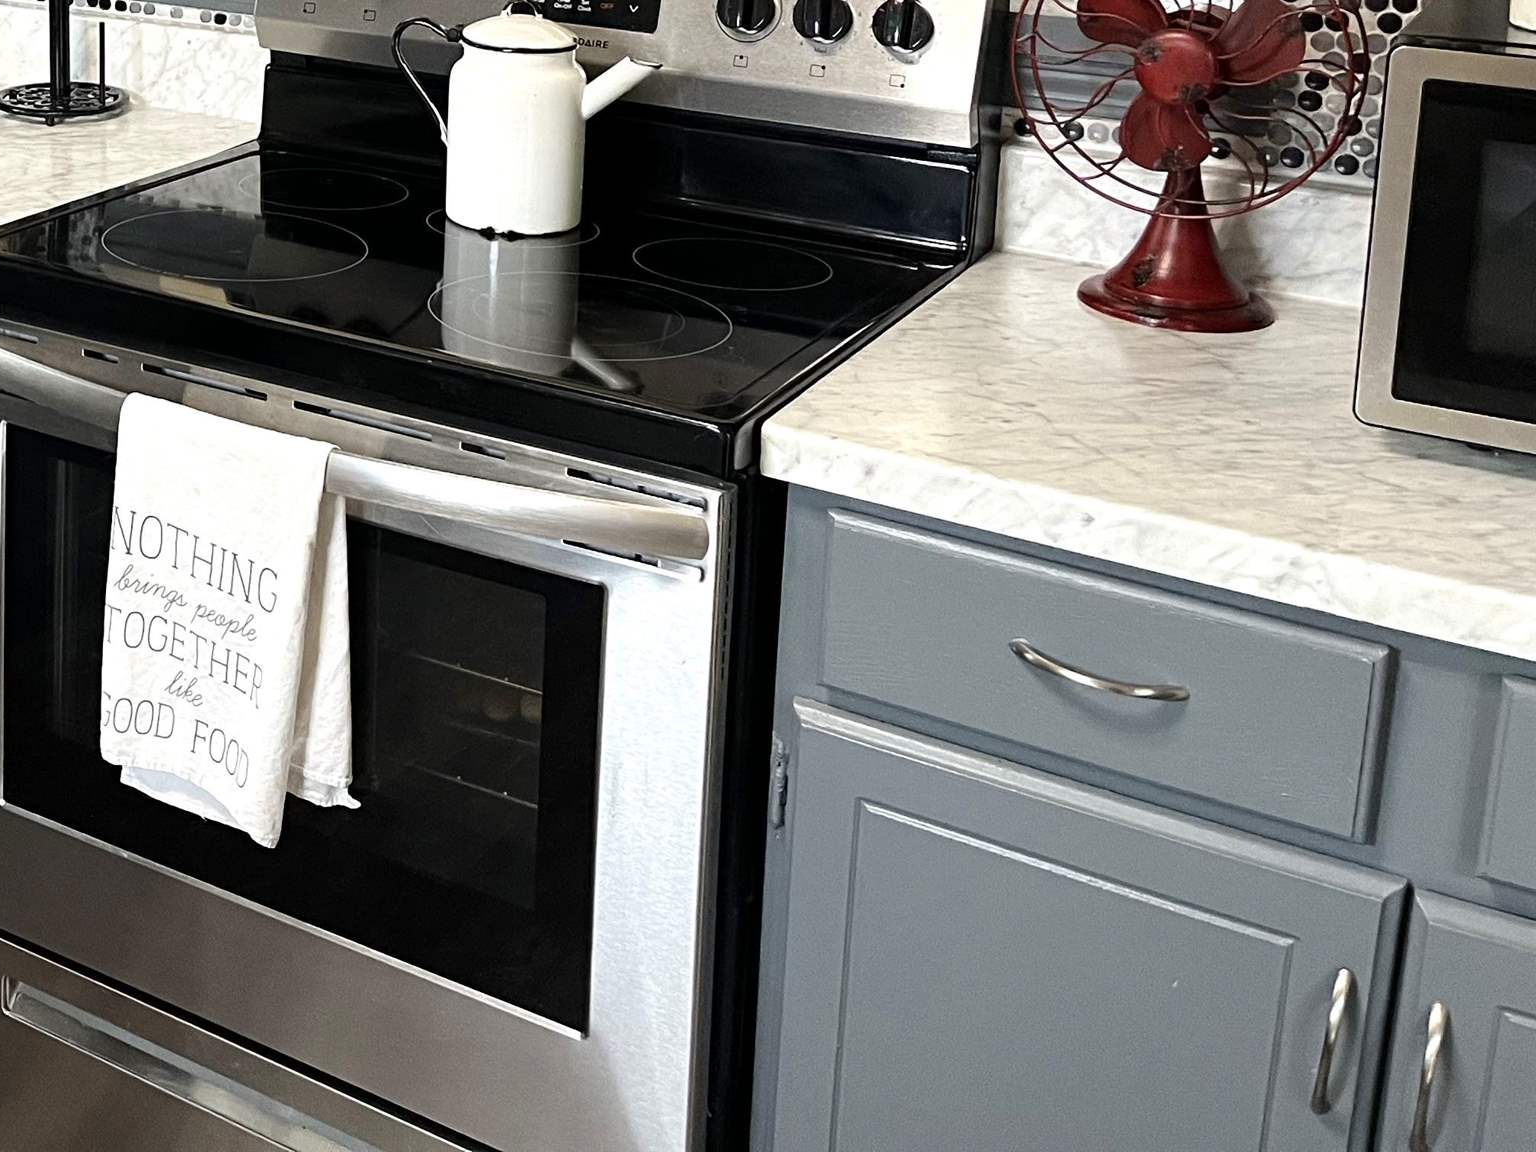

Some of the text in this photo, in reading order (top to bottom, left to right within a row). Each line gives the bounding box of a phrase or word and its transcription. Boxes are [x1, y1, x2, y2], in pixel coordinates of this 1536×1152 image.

[111, 505, 279, 614] NOTHING
[113, 563, 258, 642] brings people
[105, 604, 264, 710] TOGETHER
[164, 670, 204, 708] like
[190, 718, 250, 789] FOOD
